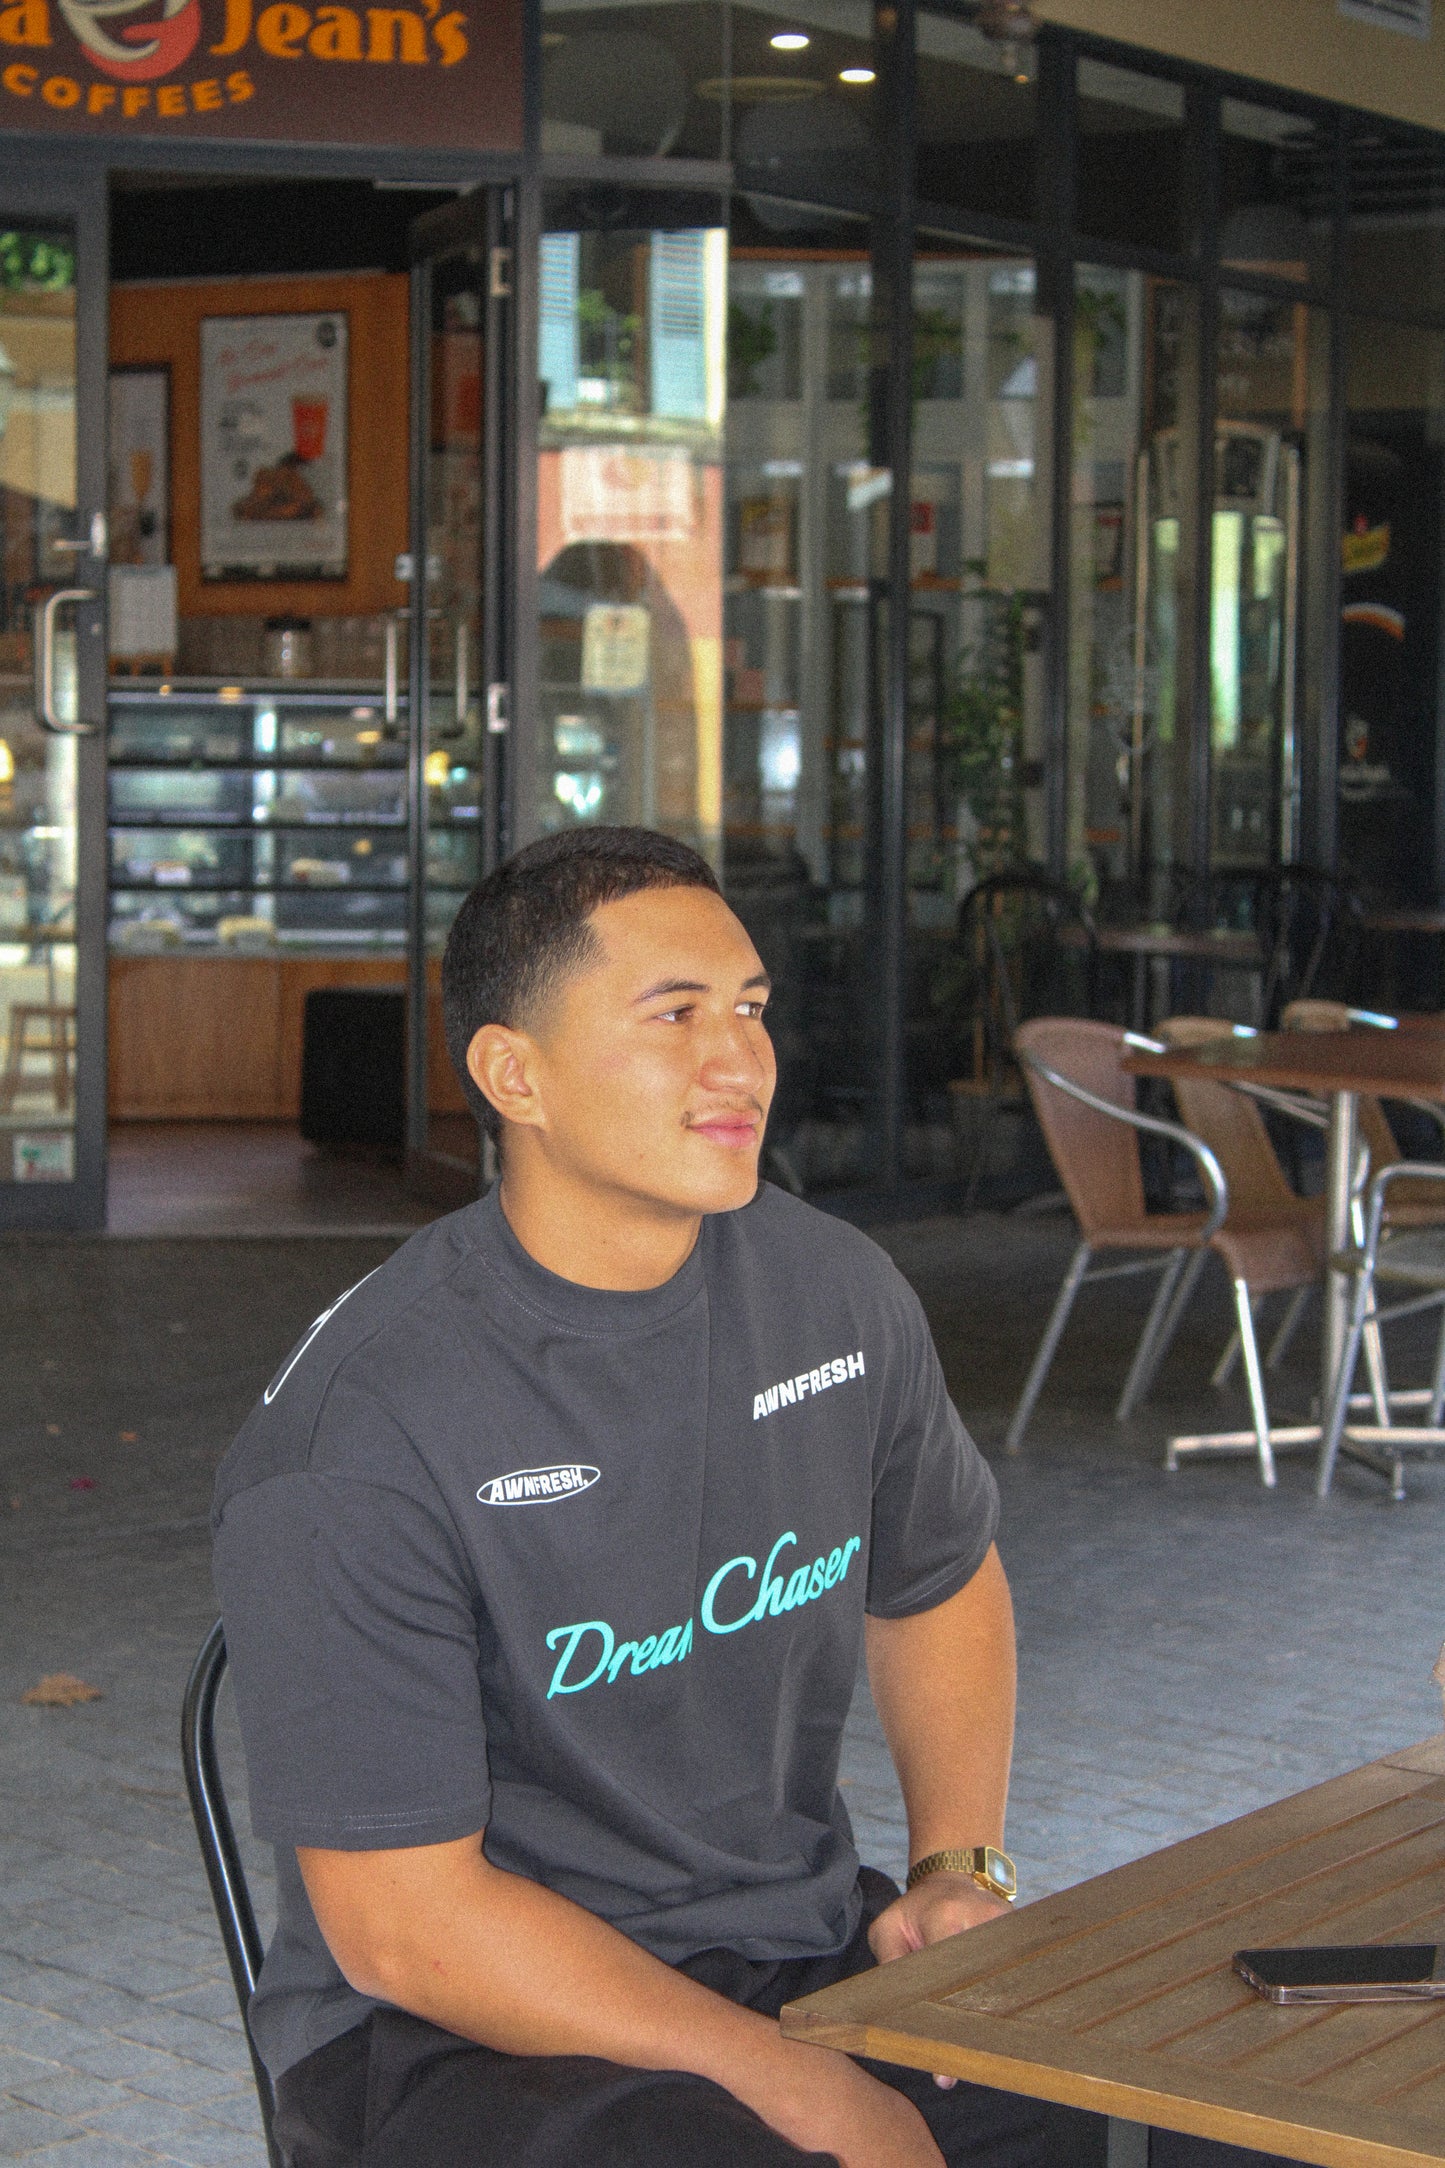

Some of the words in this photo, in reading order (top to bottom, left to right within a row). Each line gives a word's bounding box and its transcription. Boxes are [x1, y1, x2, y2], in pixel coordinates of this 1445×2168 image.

[209, 0, 469, 67] Jean's
[2, 63, 256, 118] COFFEES
[752, 1351, 866, 1421] AWNFRESH
[700, 1530, 862, 1635] Chaser
